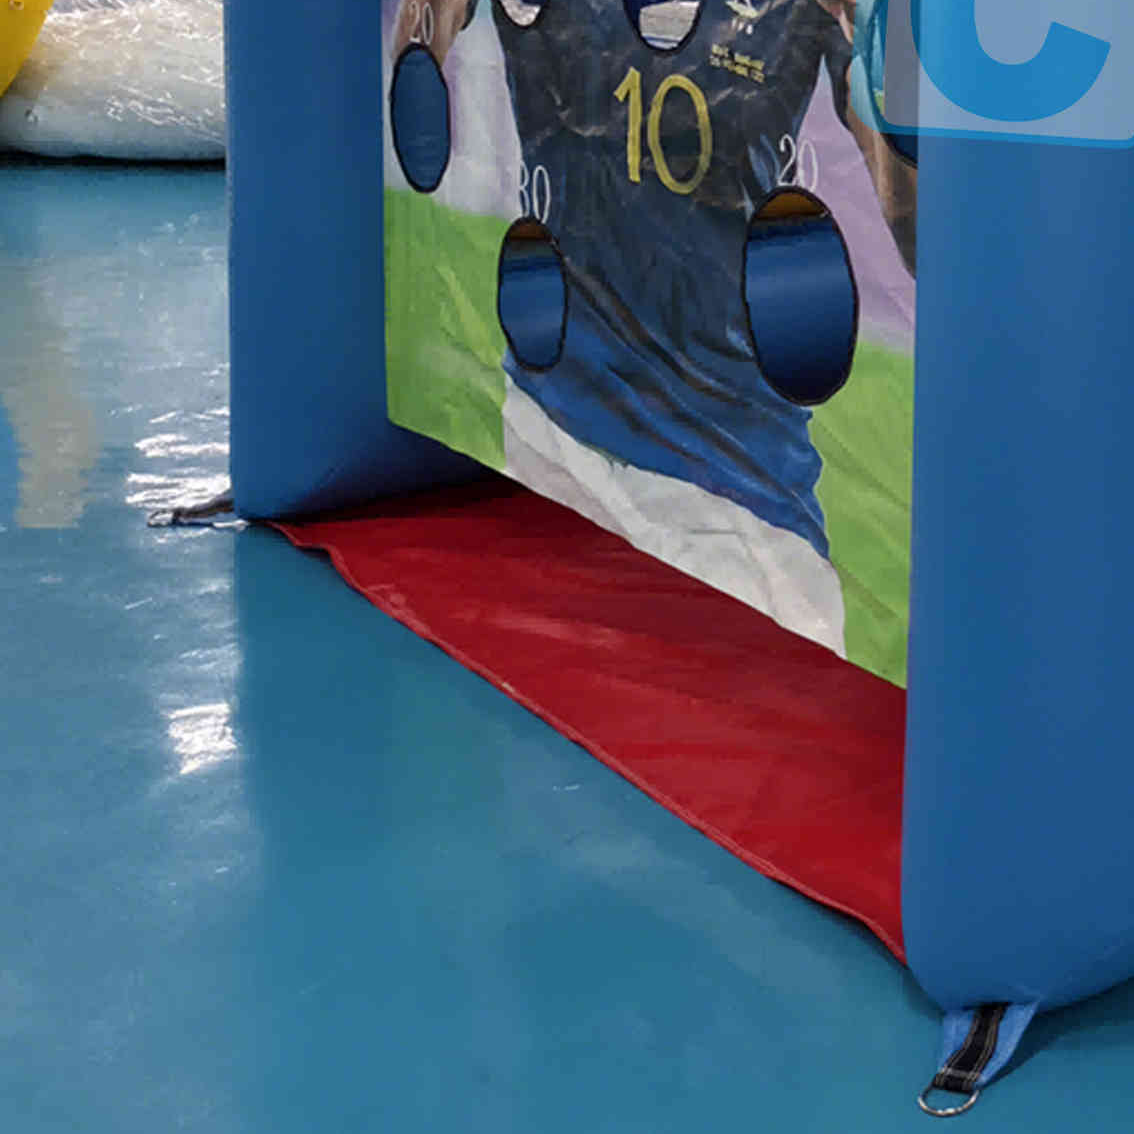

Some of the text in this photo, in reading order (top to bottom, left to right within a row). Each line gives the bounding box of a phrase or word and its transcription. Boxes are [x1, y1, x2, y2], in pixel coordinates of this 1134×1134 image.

[408, 0, 434, 45] 20
[613, 66, 713, 194] 10
[777, 133, 818, 193] 20
